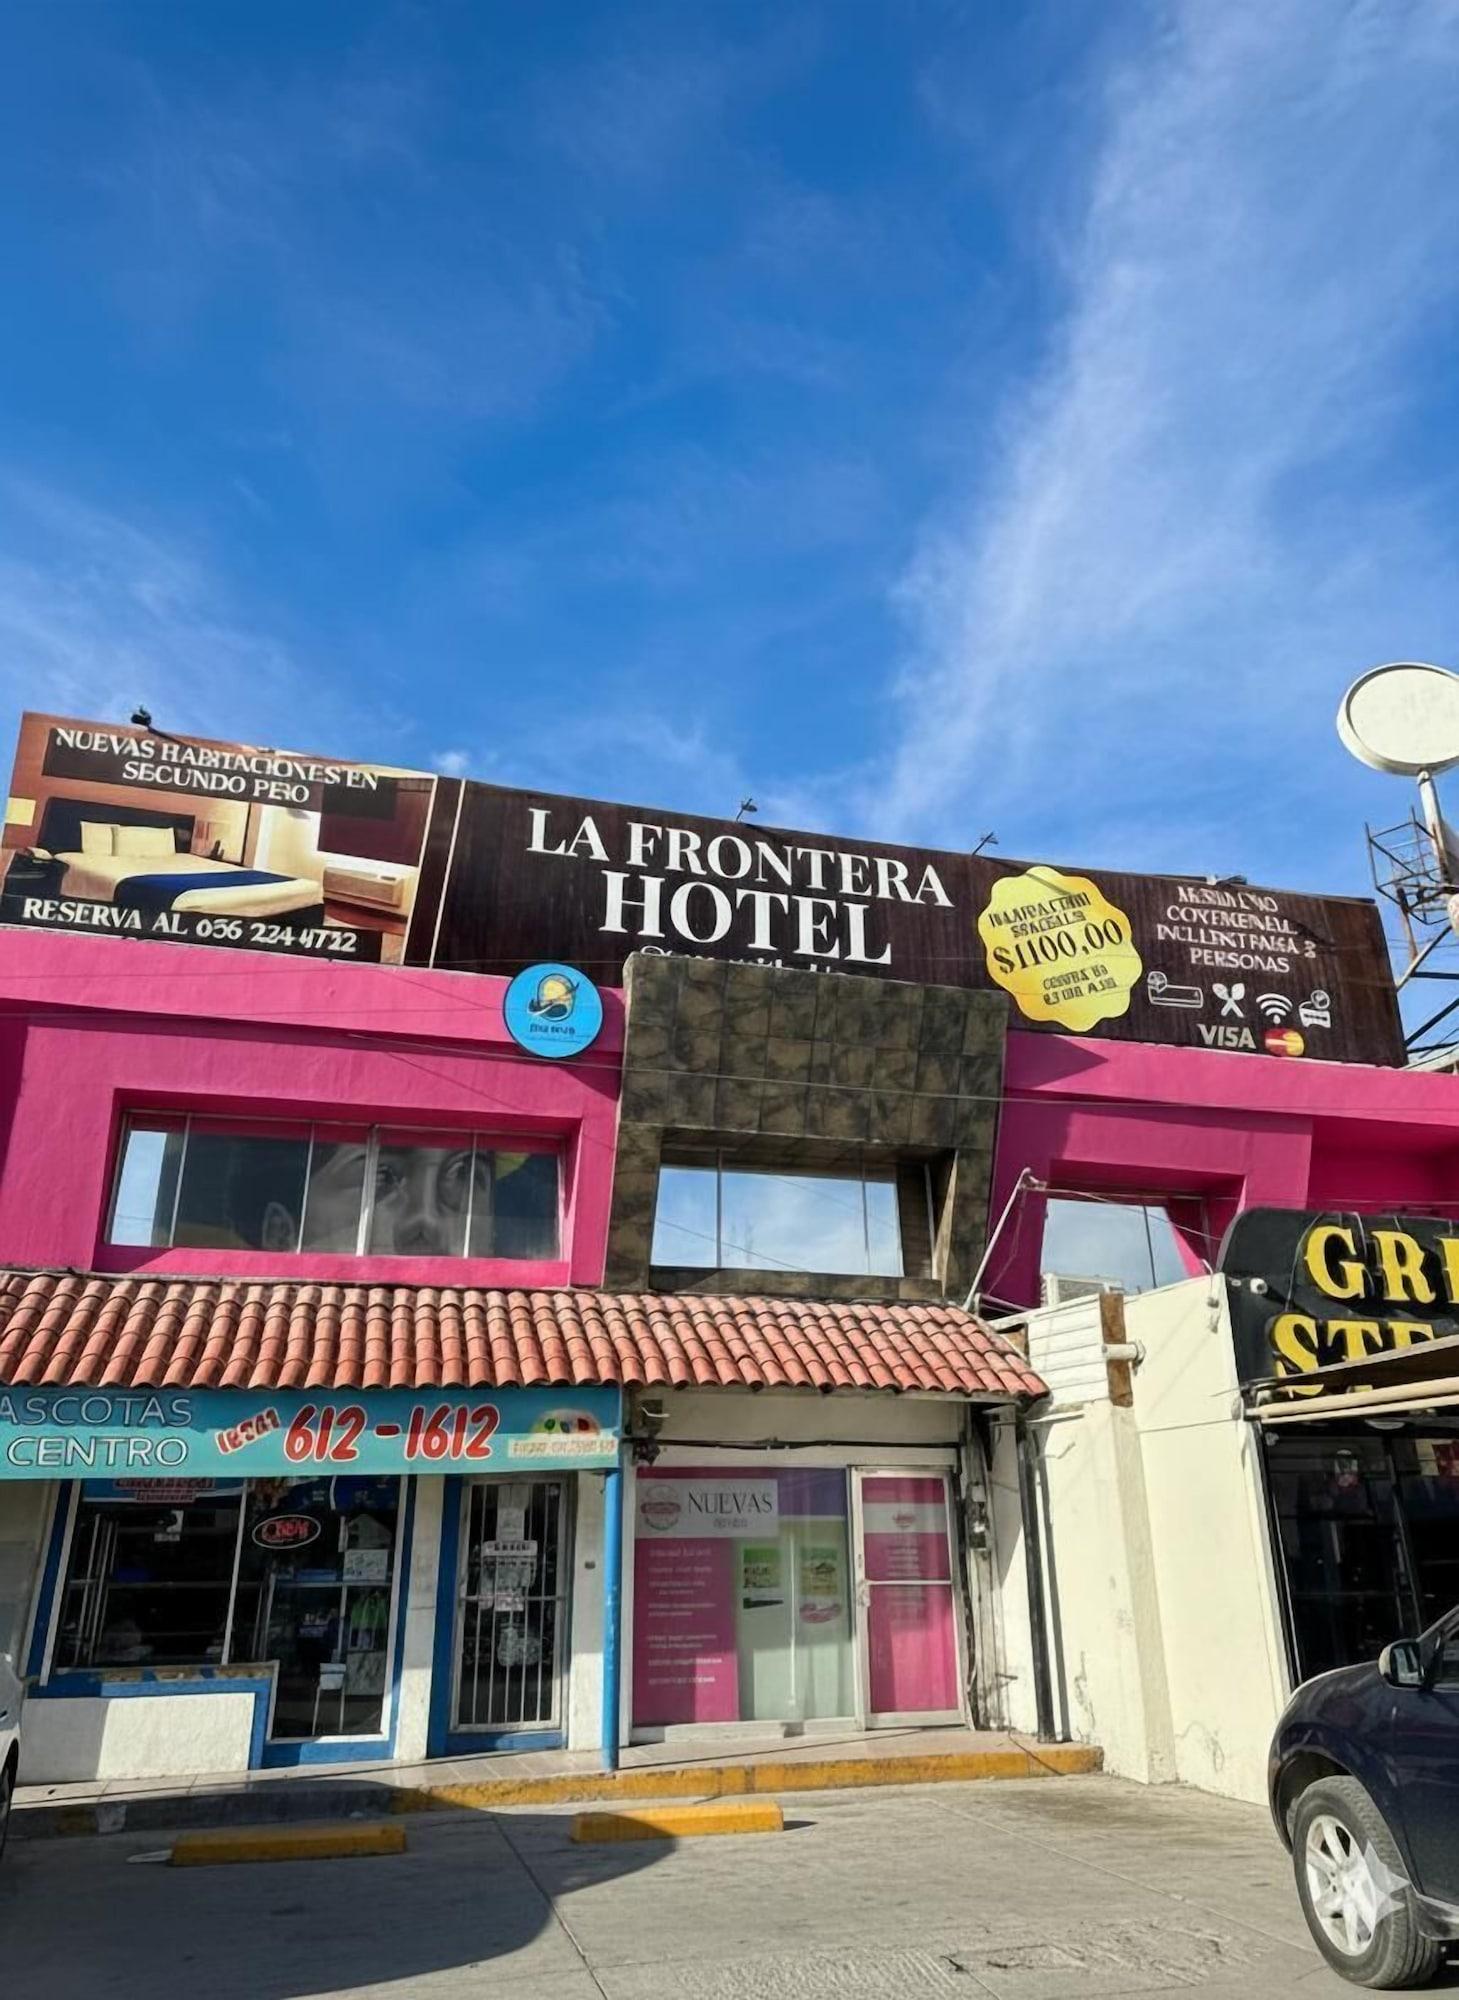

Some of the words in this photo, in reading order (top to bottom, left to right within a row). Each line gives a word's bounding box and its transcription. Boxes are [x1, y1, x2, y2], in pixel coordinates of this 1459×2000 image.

[55, 727, 154, 760] NUEVAS
[527, 808, 609, 862] LA
[626, 823, 955, 907] FRONTERA
[22, 897, 143, 930] RESERVA
[151, 911, 188, 935] AL
[598, 869, 893, 965] HOTEL
[1190, 947, 1290, 974] PERSONAS
[1197, 1023, 1257, 1050] VISA
[0, 1395, 193, 1428] ASCOTAS
[7, 1435, 189, 1467] CENTRO
[688, 1491, 772, 1514] NUEVAS
